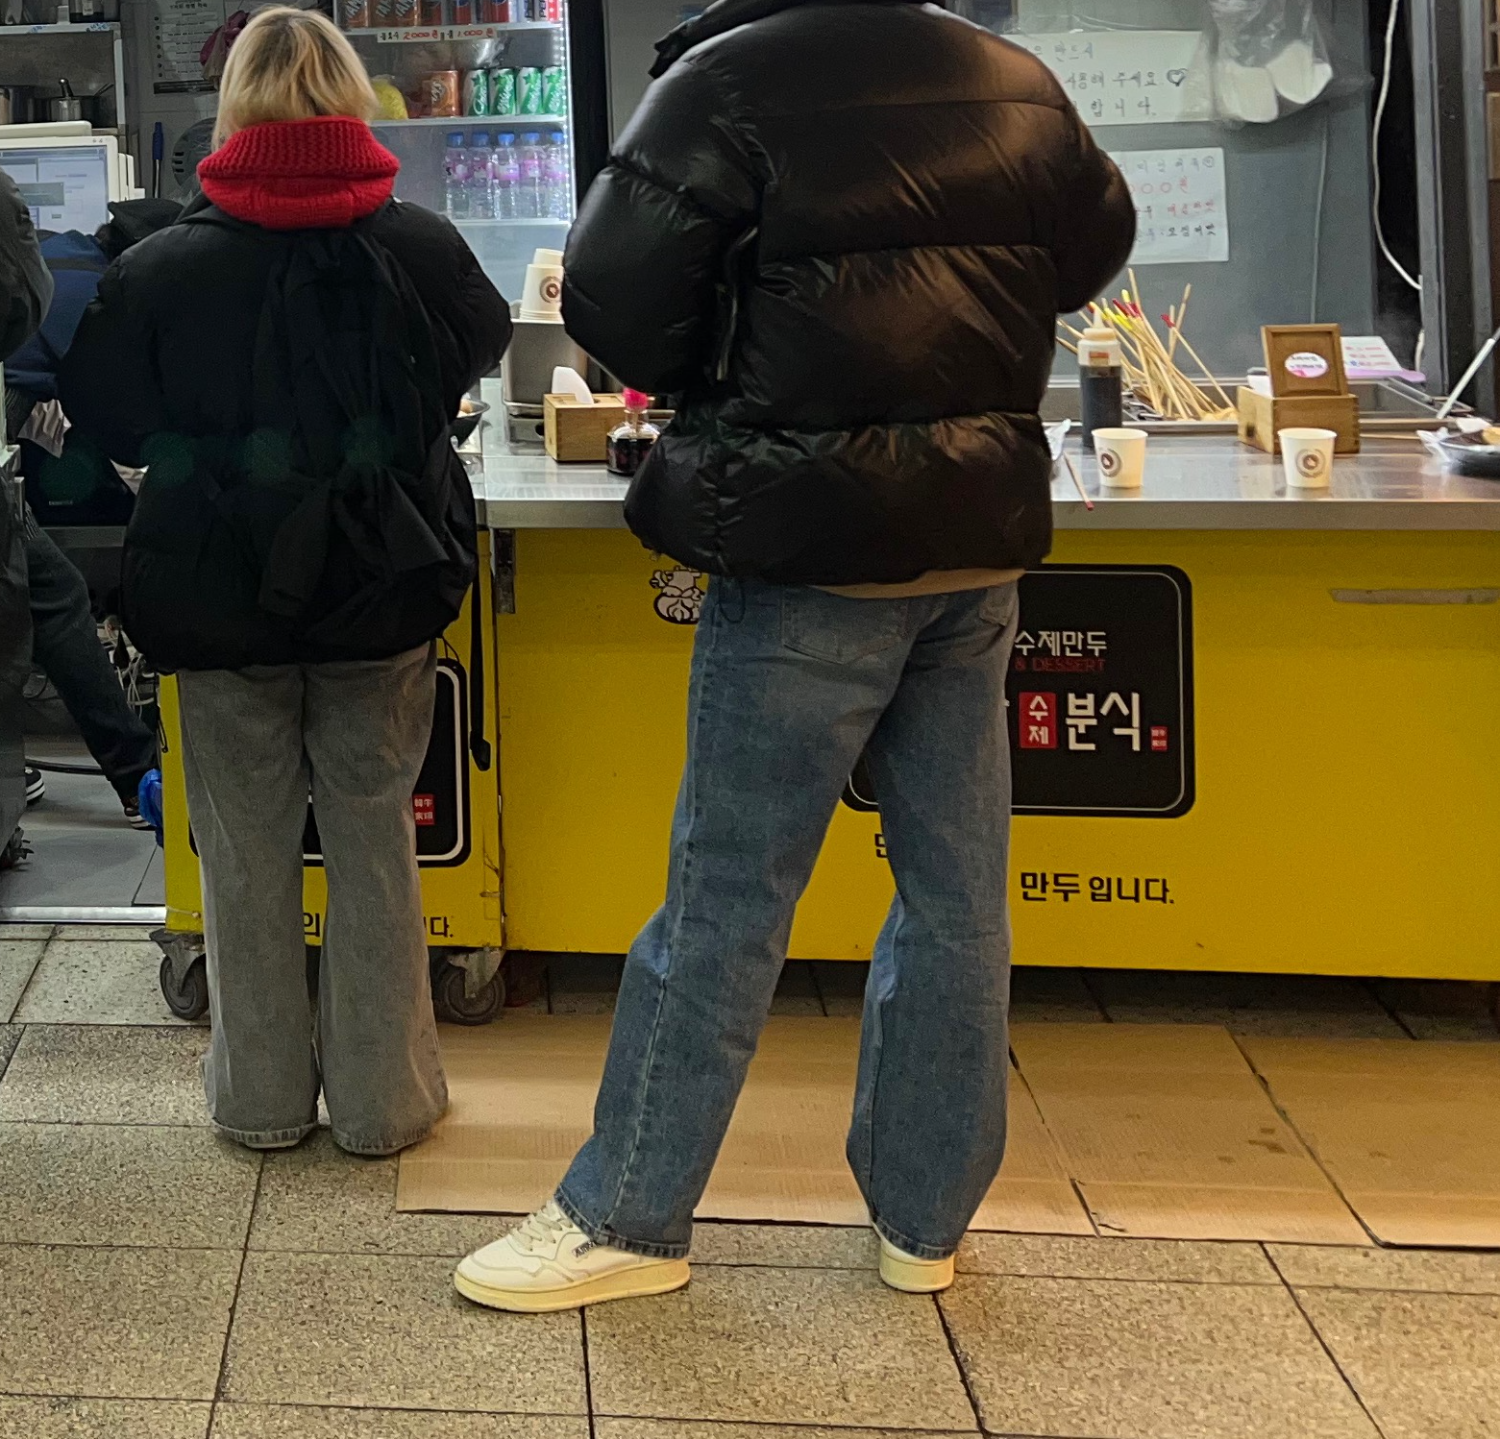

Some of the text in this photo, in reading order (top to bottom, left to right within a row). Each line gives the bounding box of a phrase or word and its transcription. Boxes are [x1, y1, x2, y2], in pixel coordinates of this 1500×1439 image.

[1015, 631, 1107, 657] 수제만두
[1033, 658, 1105, 671] DESSERT
[1066, 692, 1141, 751] 분식
[1021, 872, 1174, 904] 만두 입니다.
